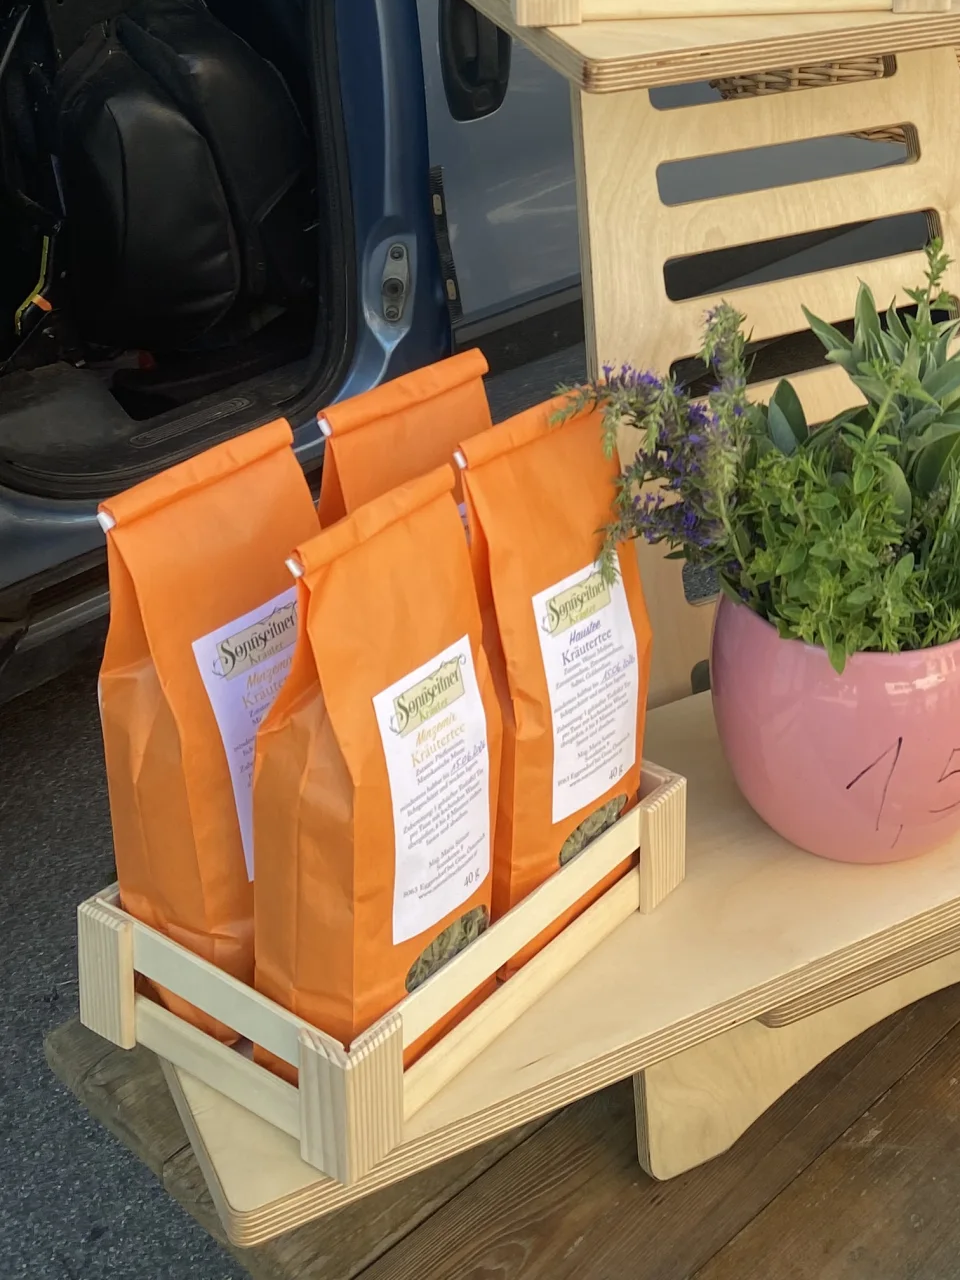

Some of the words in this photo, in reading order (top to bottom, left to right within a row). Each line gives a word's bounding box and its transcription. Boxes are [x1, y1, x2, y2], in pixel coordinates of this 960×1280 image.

[547, 579, 607, 630] Sonnseitner
[219, 615, 296, 673] Sonnseitner
[561, 629, 613, 666] Kräutertee
[569, 620, 602, 646] Haustee
[248, 640, 284, 666] Kräuter
[241, 679, 286, 710] Kräute
[395, 668, 459, 731] Sonnseitner
[411, 723, 466, 768] Kräutertee
[608, 766, 618, 780] 40
[463, 871, 474, 888] 40
[474, 867, 481, 882] g
